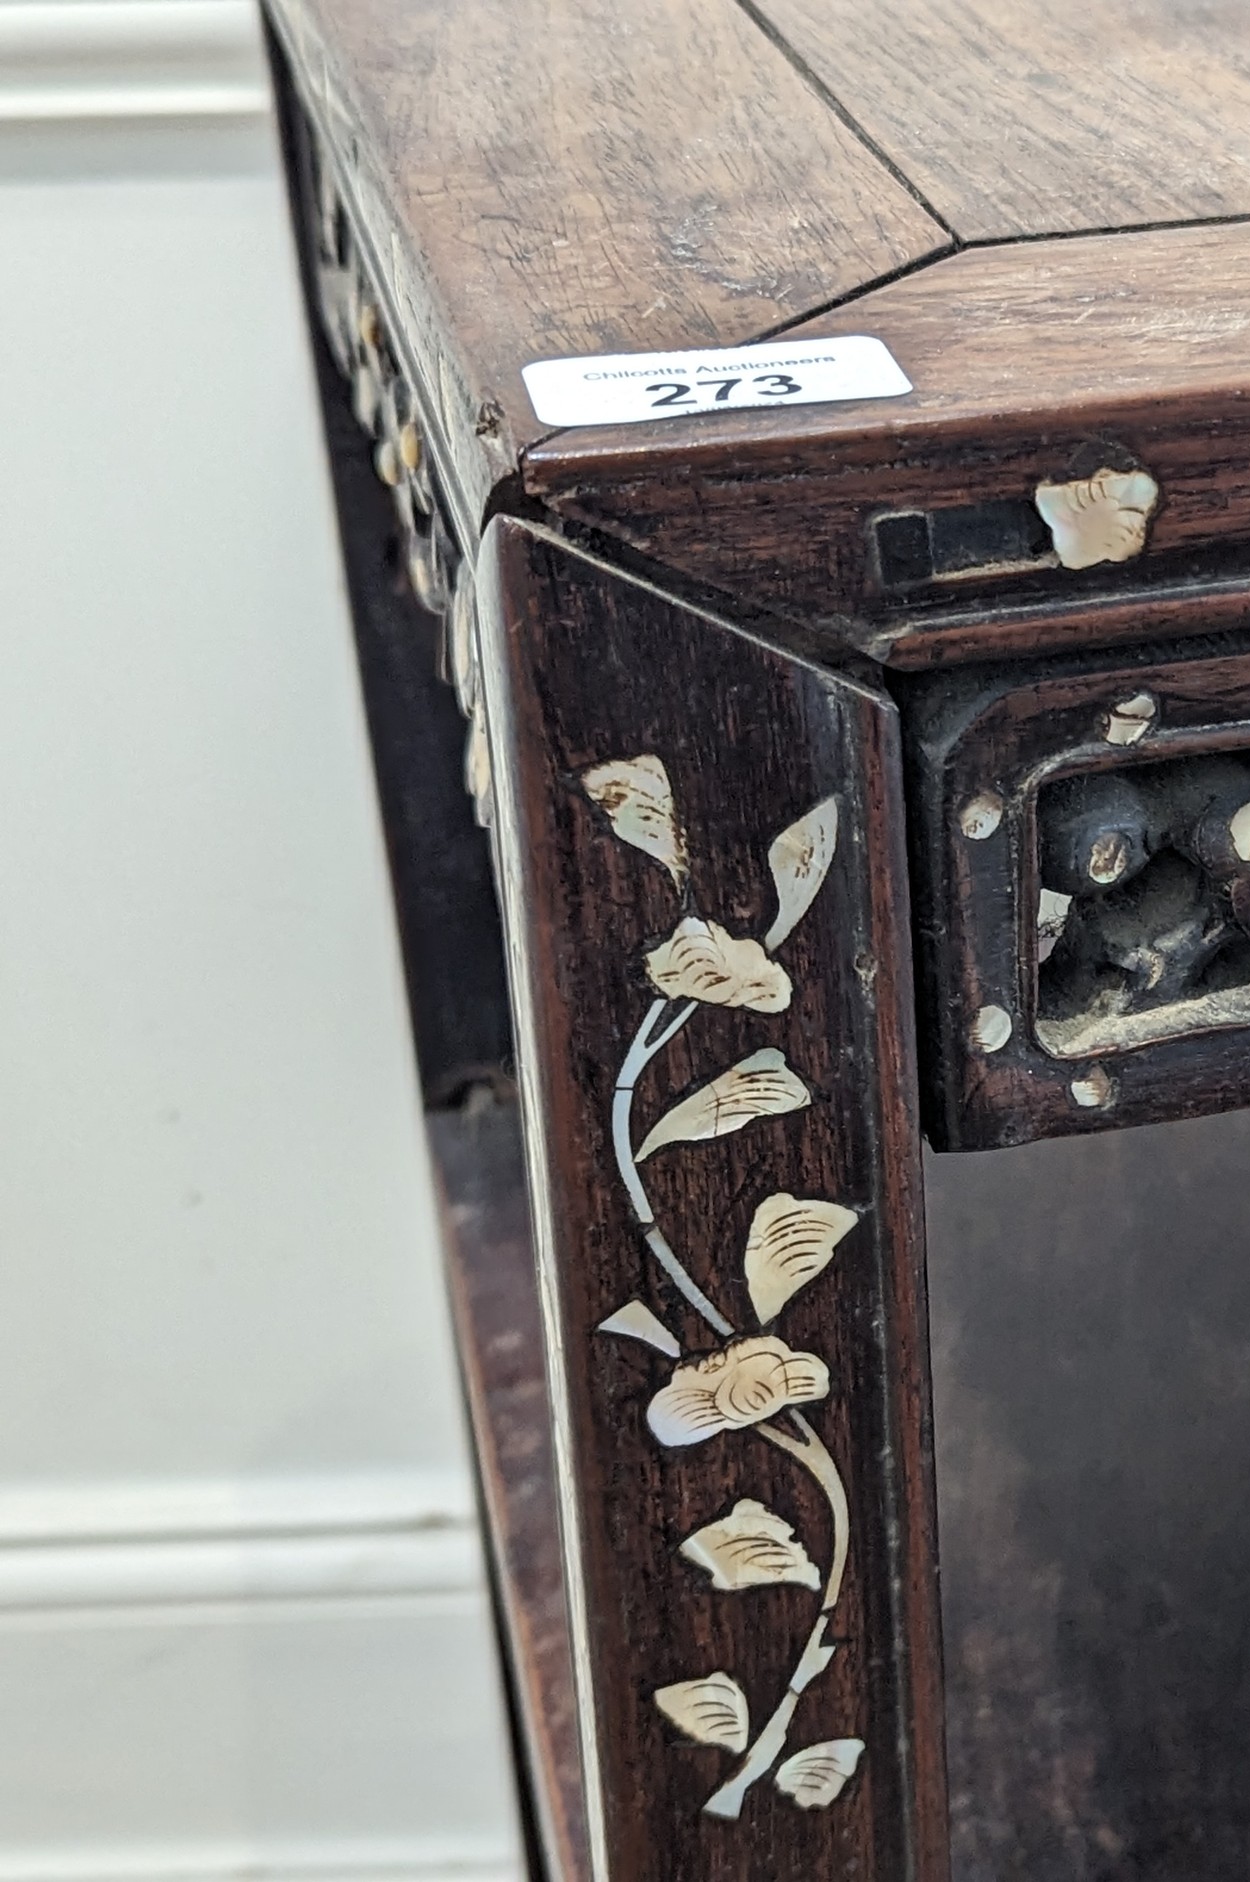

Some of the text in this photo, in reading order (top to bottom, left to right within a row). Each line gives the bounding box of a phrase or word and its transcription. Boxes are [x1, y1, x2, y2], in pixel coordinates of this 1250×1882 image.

[583, 354, 836, 382] Chilcotts Auctioneers
[645, 374, 803, 407] 273
